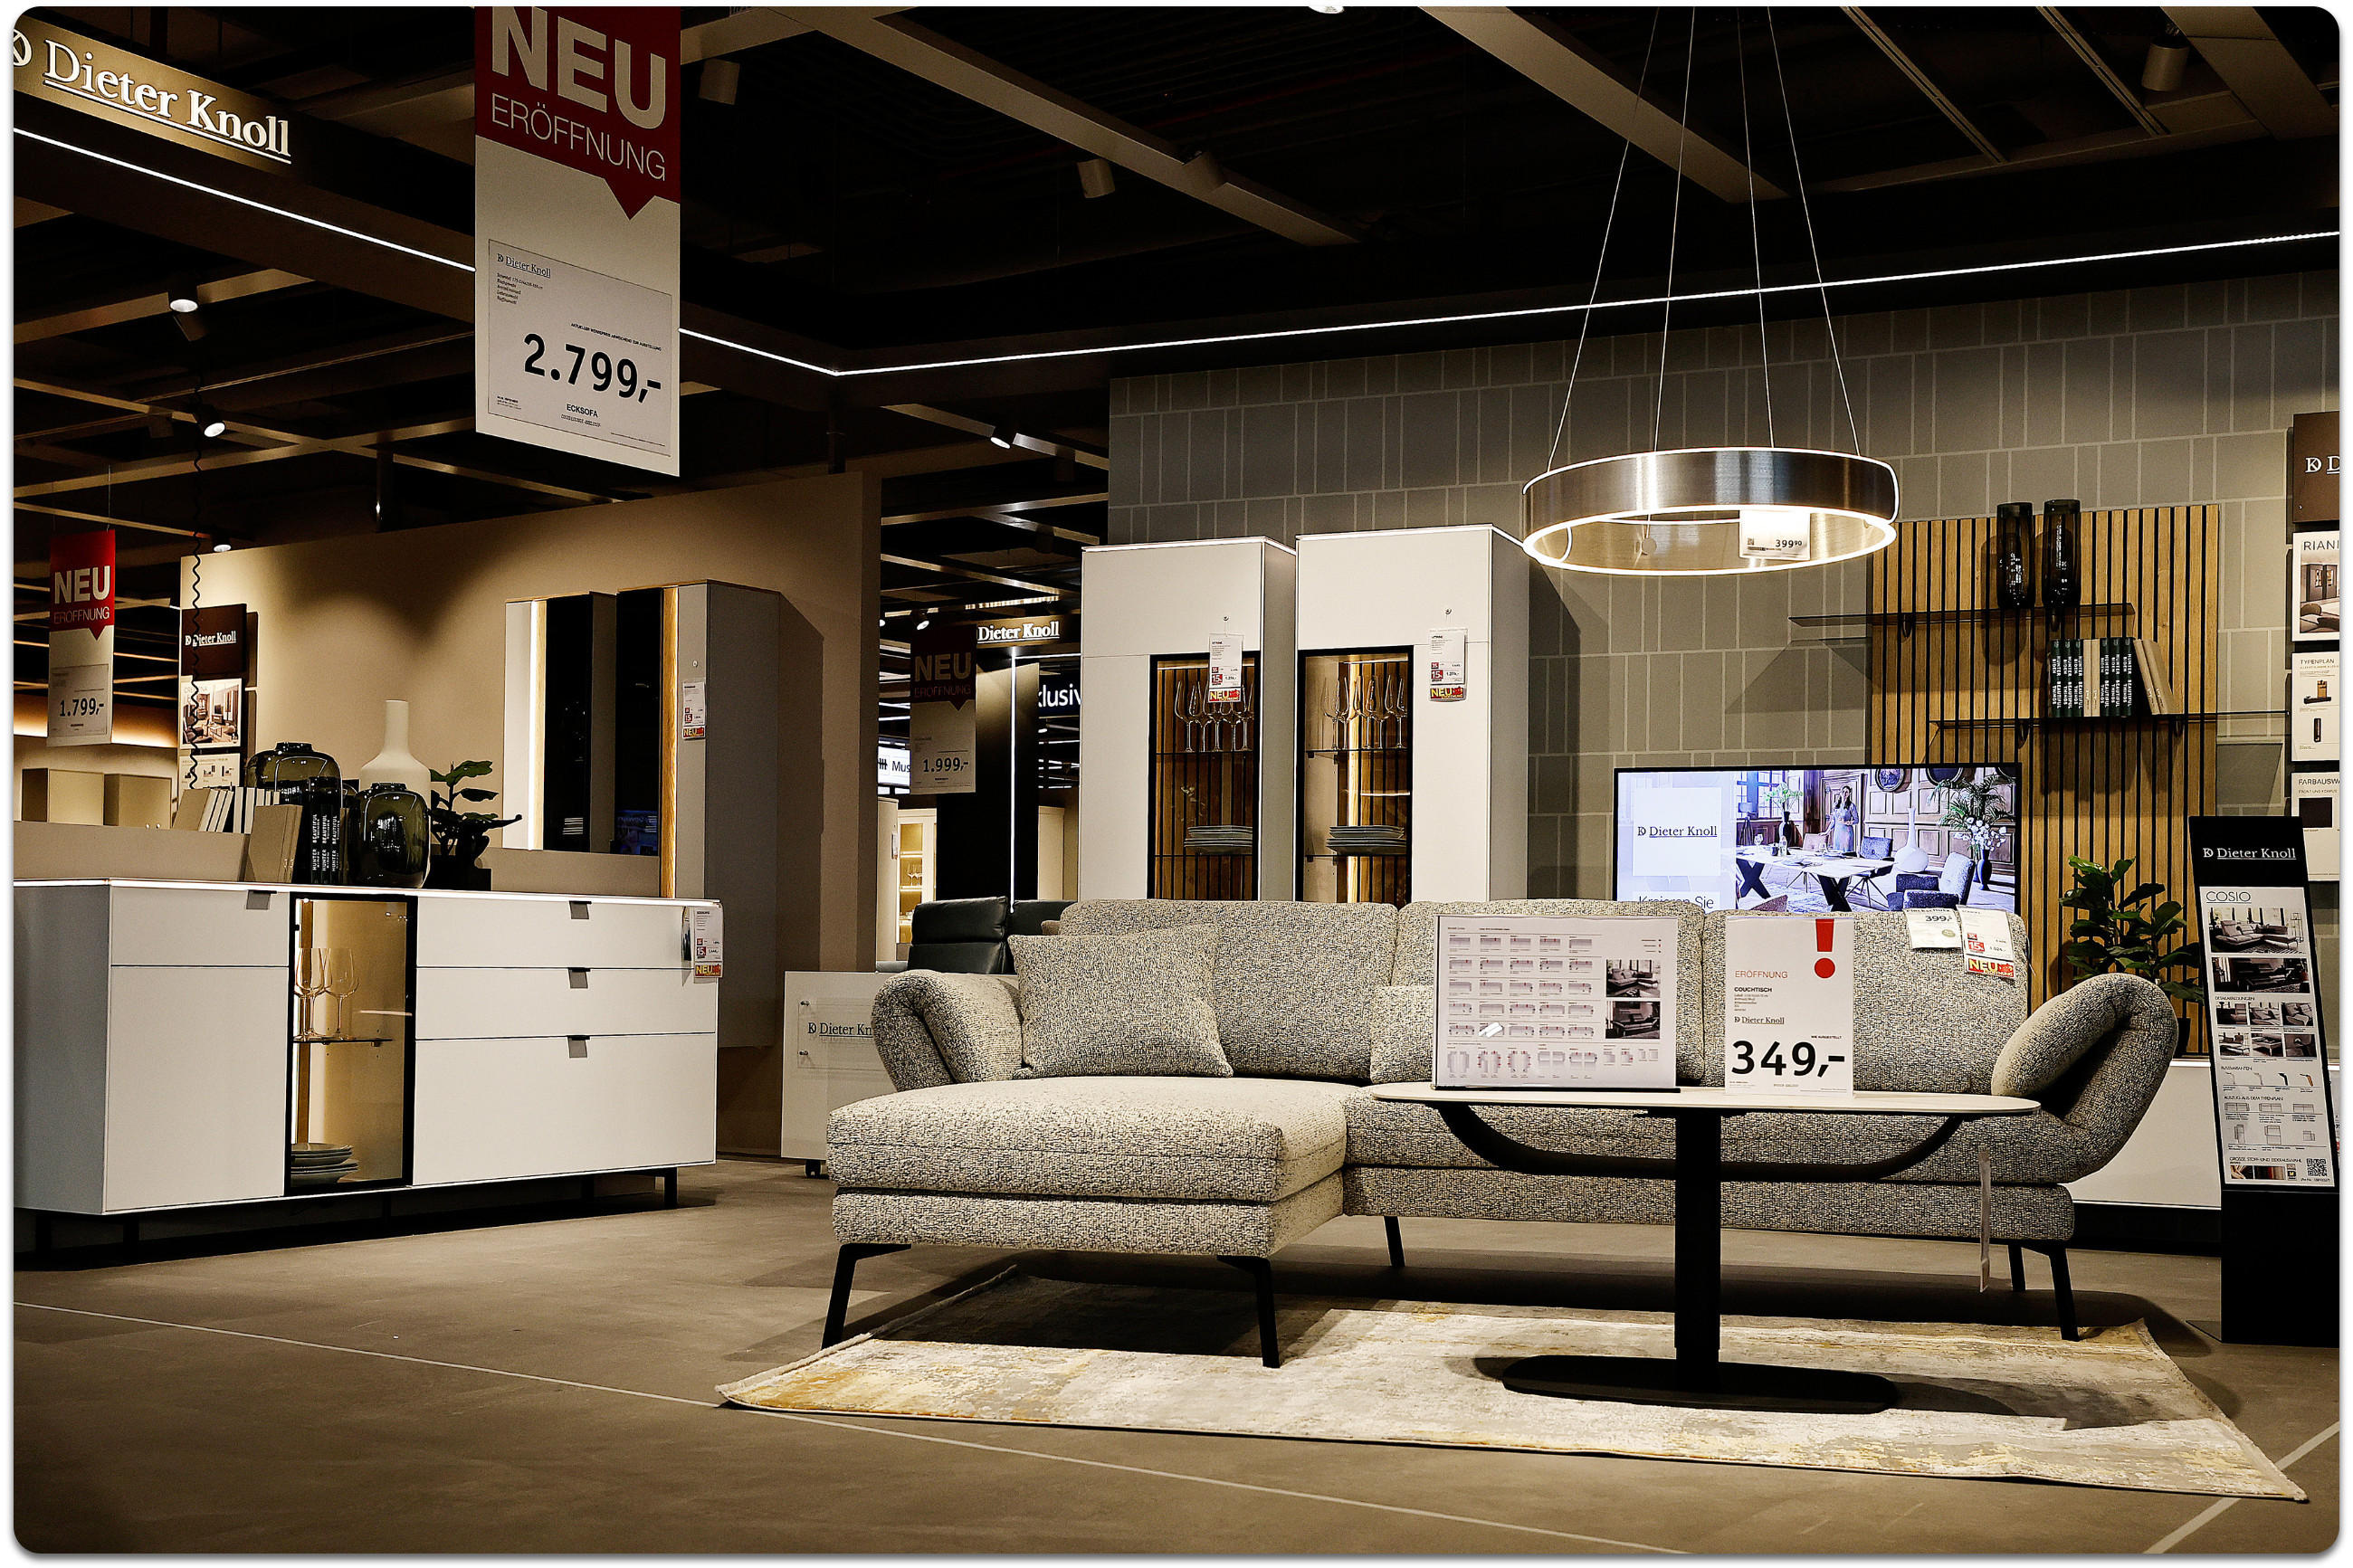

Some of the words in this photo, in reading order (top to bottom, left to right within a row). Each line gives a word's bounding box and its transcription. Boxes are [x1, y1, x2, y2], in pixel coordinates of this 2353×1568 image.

[491, 6, 667, 130] NEU
[43, 39, 178, 118] Dieter
[186, 89, 291, 157] Knoll
[491, 91, 666, 182] ERÖFFNUNG
[506, 256, 529, 271] Dieter
[531, 263, 550, 278] Knoll
[523, 333, 662, 404] 2.799,-
[566, 404, 599, 418] ECKSOFA
[54, 565, 110, 604] NEU
[216, 630, 236, 642] Knoll
[977, 624, 1022, 641] Dieter
[1022, 621, 1060, 639] Knoll
[914, 651, 972, 682] NEU
[1209, 690, 1230, 700] NEU
[1431, 689, 1453, 698] NEU
[60, 698, 104, 717] 1.799,-
[923, 756, 969, 773] 1.999,-
[1649, 826, 1684, 836] Dieter
[1688, 825, 1718, 836] Knoll
[2217, 848, 2258, 858] Dieter
[2261, 848, 2297, 858] Knoll
[1695, 896, 1714, 908] Sie
[2206, 891, 2251, 901] COSIO
[695, 965, 713, 974] NEU
[1968, 958, 1998, 974] NEU
[1734, 969, 1788, 979] ERÖFFNUNG
[1741, 1016, 1764, 1024] Dieter
[1766, 1016, 1785, 1024] Knoll
[819, 1022, 854, 1036] Dieter
[1731, 1040, 1845, 1079] 349,-
